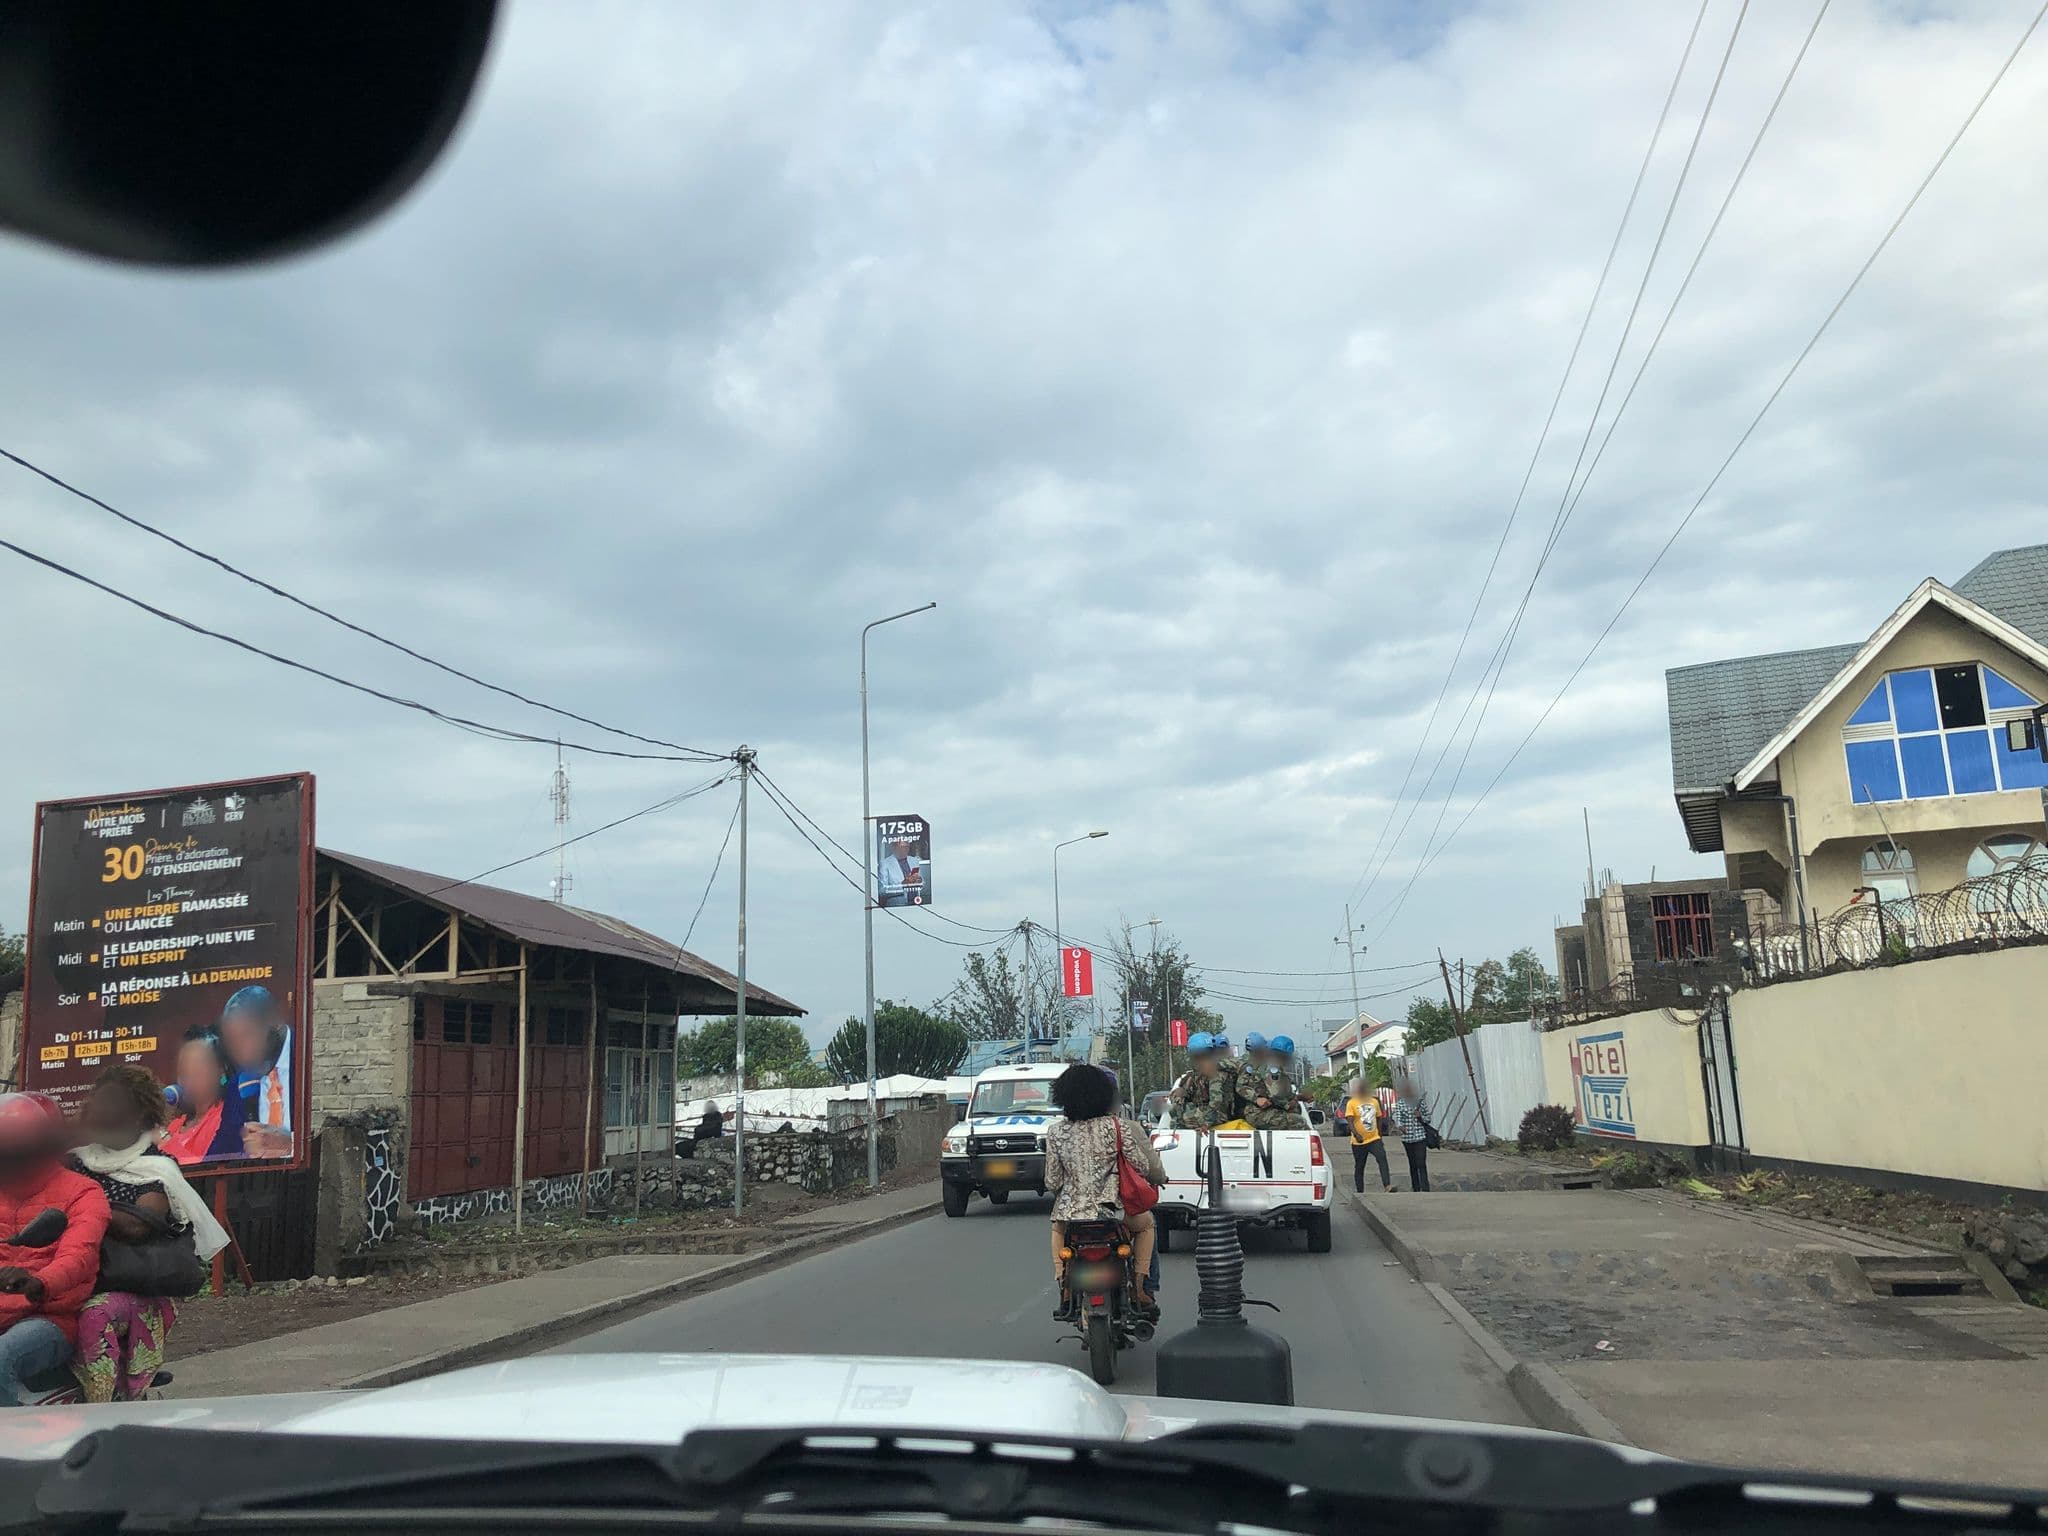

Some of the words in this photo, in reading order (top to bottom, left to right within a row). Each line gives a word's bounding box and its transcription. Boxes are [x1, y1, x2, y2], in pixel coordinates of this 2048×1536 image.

[84, 816, 116, 830] NOTRE
[118, 813, 146, 825] MOIS
[880, 821, 923, 835] 175GB
[99, 825, 134, 839] PRIÈRE
[888, 834, 921, 844] partager
[175, 846, 229, 862] d'adoration
[102, 844, 145, 883] 30
[153, 857, 244, 876] D'ENSEIGNEMENT
[105, 907, 132, 921] UNE
[134, 903, 181, 919] PIERRE
[181, 893, 249, 913] RAMASSÉE
[53, 919, 85, 933] Matin
[104, 921, 123, 934] OU
[125, 914, 174, 932] LANCÉE
[103, 944, 119, 956] LE
[121, 936, 204, 955] LEADERSHIP:
[206, 932, 233, 945] UNE
[234, 929, 256, 942] VIE
[58, 953, 82, 966] Midi
[103, 957, 118, 969] ET
[120, 955, 139, 968] UN
[141, 949, 187, 965] ESPRIT
[101, 983, 118, 995] LA
[119, 976, 179, 993] RÉPONSE
[180, 972, 191, 986] À
[192, 973, 208, 986] LA
[210, 966, 273, 984] DEMANDE
[58, 994, 81, 1007] Soir
[101, 995, 117, 1007] DE
[119, 990, 160, 1005] MOÏSE
[55, 1033, 70, 1043] Du
[70, 1029, 99, 1042] 01-11
[100, 1030, 114, 1040] au
[115, 1025, 143, 1038] 30-11
[43, 1048, 66, 1058] 6h-7h
[78, 1043, 109, 1055] 12h-13h
[120, 1041, 152, 1051] 15h-18h
[41, 1061, 65, 1070] Matin
[81, 1057, 101, 1067] Midi
[125, 1053, 142, 1062] Soir
[973, 1116, 1046, 1126] UN
